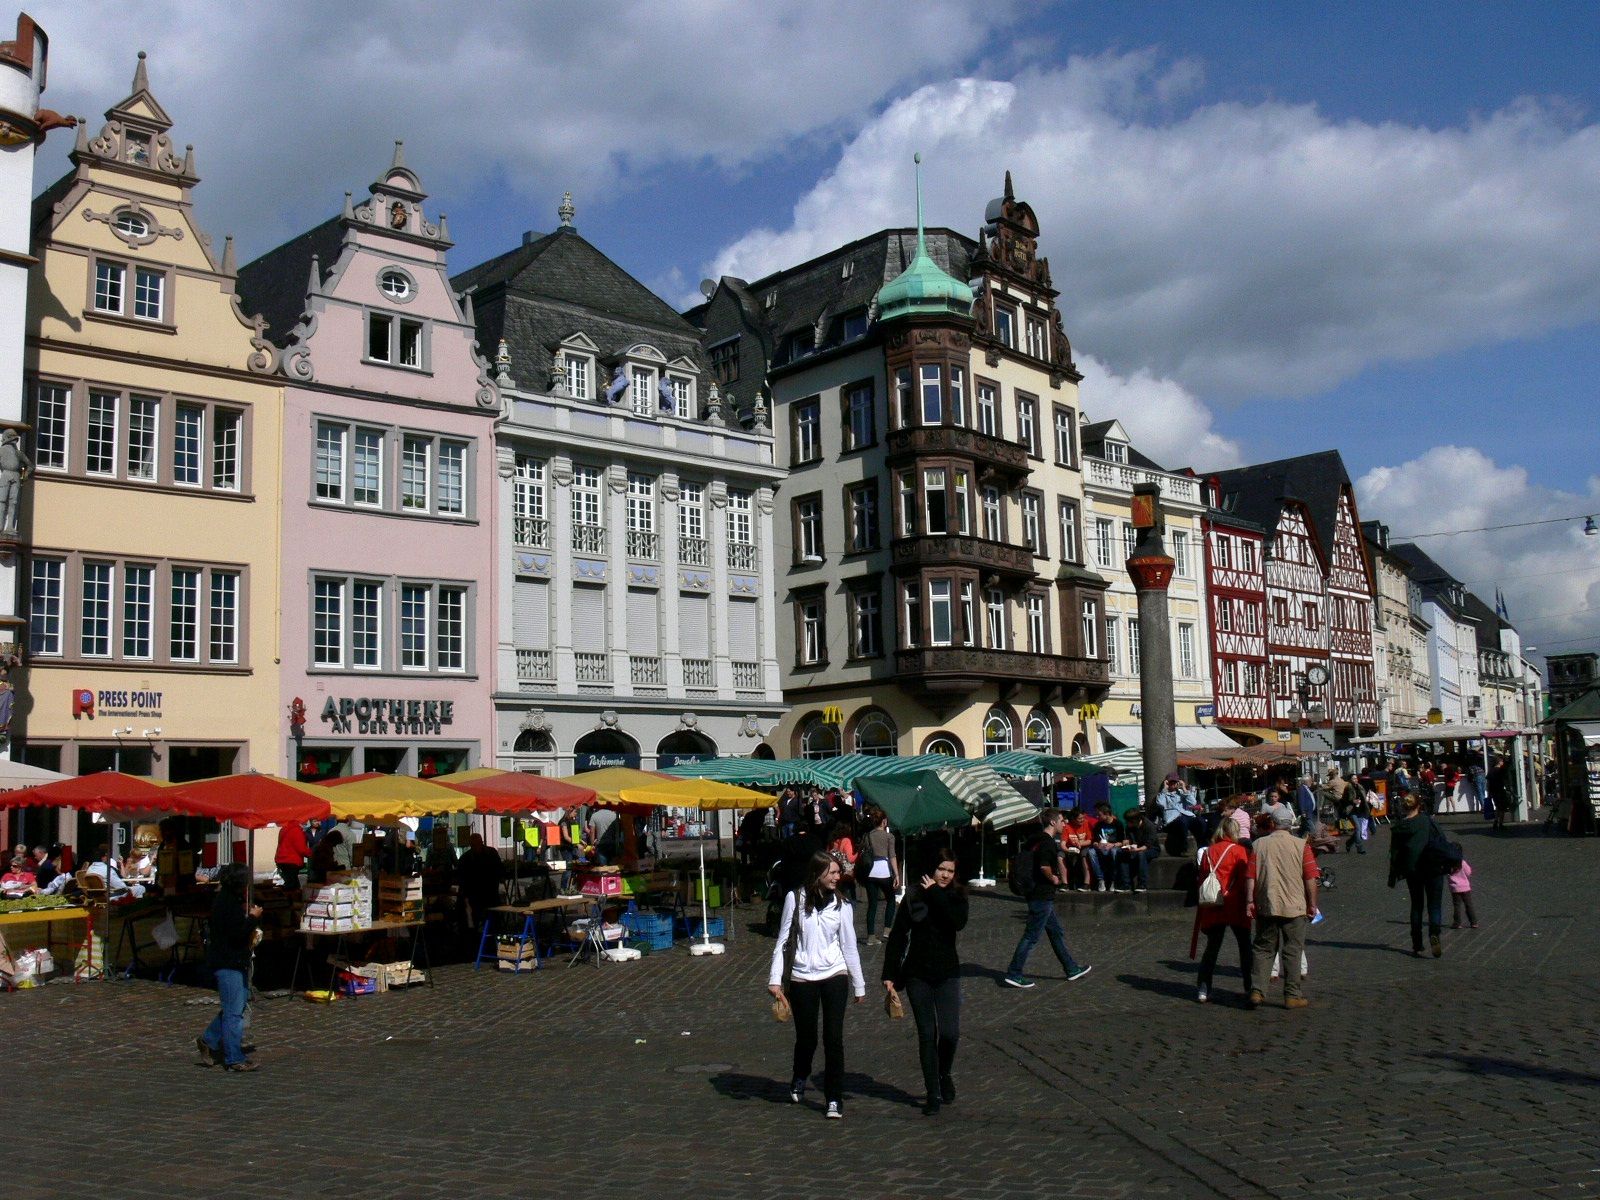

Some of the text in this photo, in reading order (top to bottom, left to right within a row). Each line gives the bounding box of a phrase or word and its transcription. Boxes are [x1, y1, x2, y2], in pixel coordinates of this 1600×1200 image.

[98, 690, 163, 709] PRESS POINT
[320, 695, 454, 723] APOTHEKE
[331, 716, 441, 735] AN DER STEIPE
[1302, 731, 1315, 739] WC
